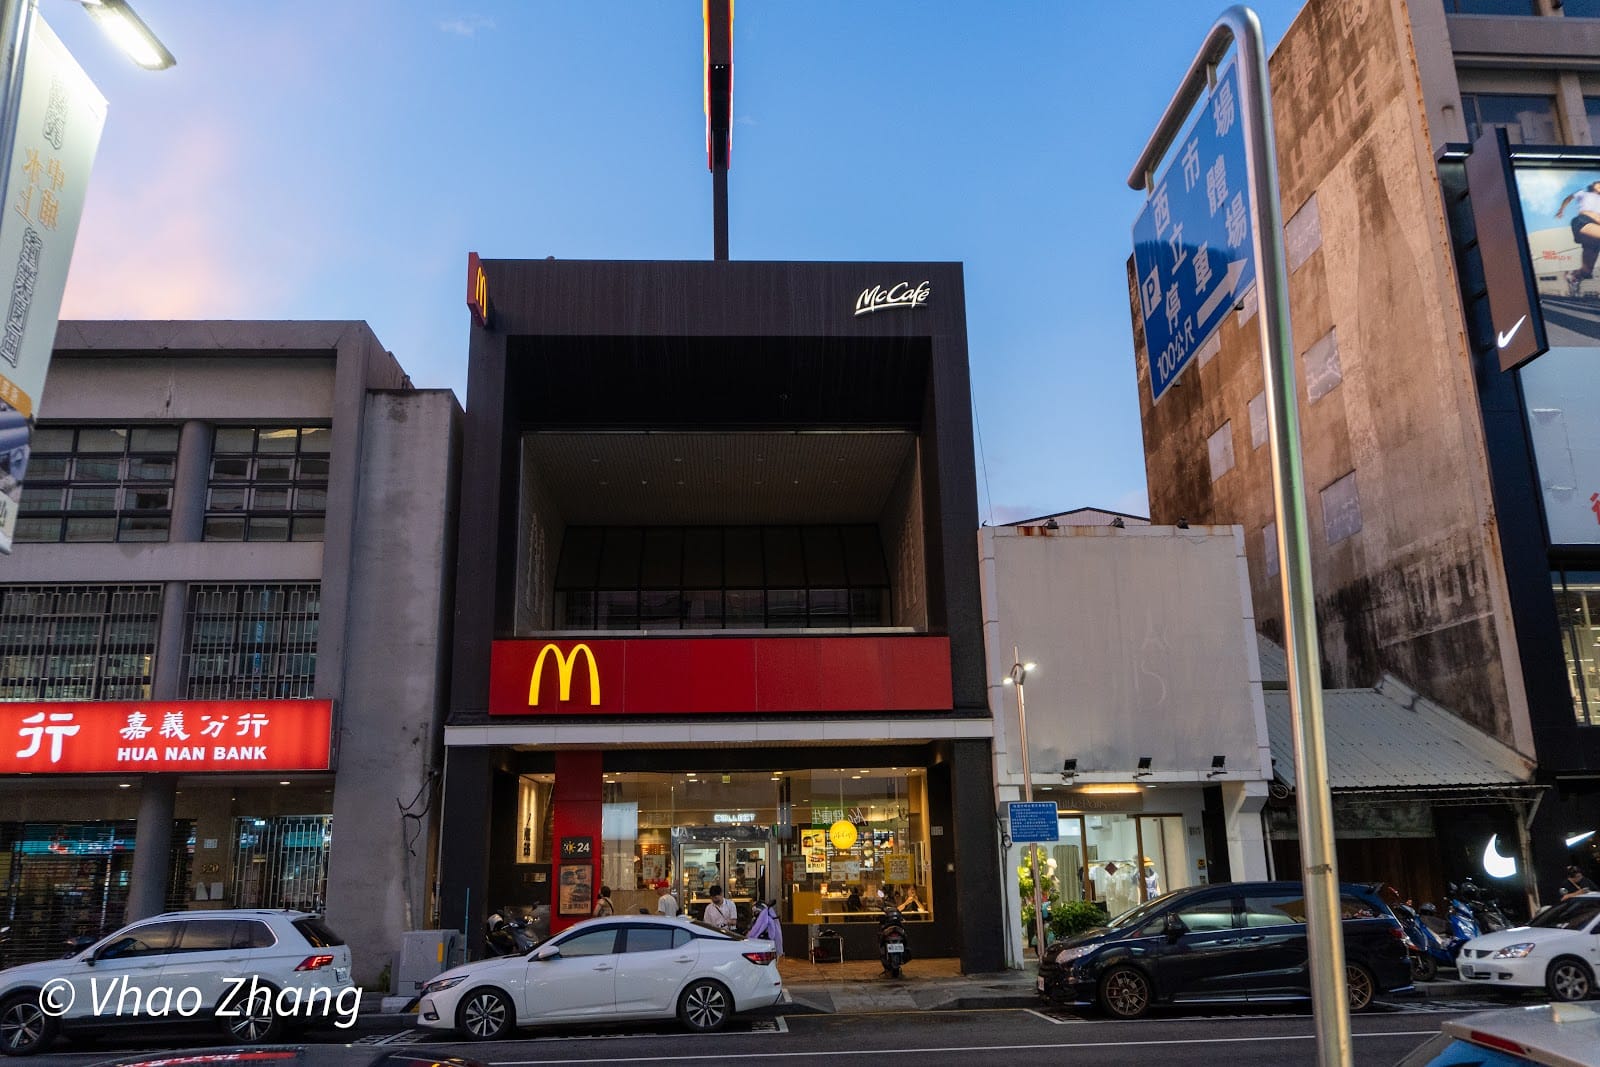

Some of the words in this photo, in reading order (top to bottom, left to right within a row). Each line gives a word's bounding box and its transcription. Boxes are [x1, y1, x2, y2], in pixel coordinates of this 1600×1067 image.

[1152, 79, 1234, 240] 西市場
[1165, 191, 1247, 336] 停車場
[854, 280, 931, 314] McCafé
[1156, 315, 1195, 385] 100公尺
[15, 711, 81, 763] 行
[118, 710, 270, 741] 嘉義分行
[117, 746, 159, 762] HUA
[164, 746, 206, 761] NAN
[213, 745, 268, 761] BANK
[576, 842, 590, 853] 24
